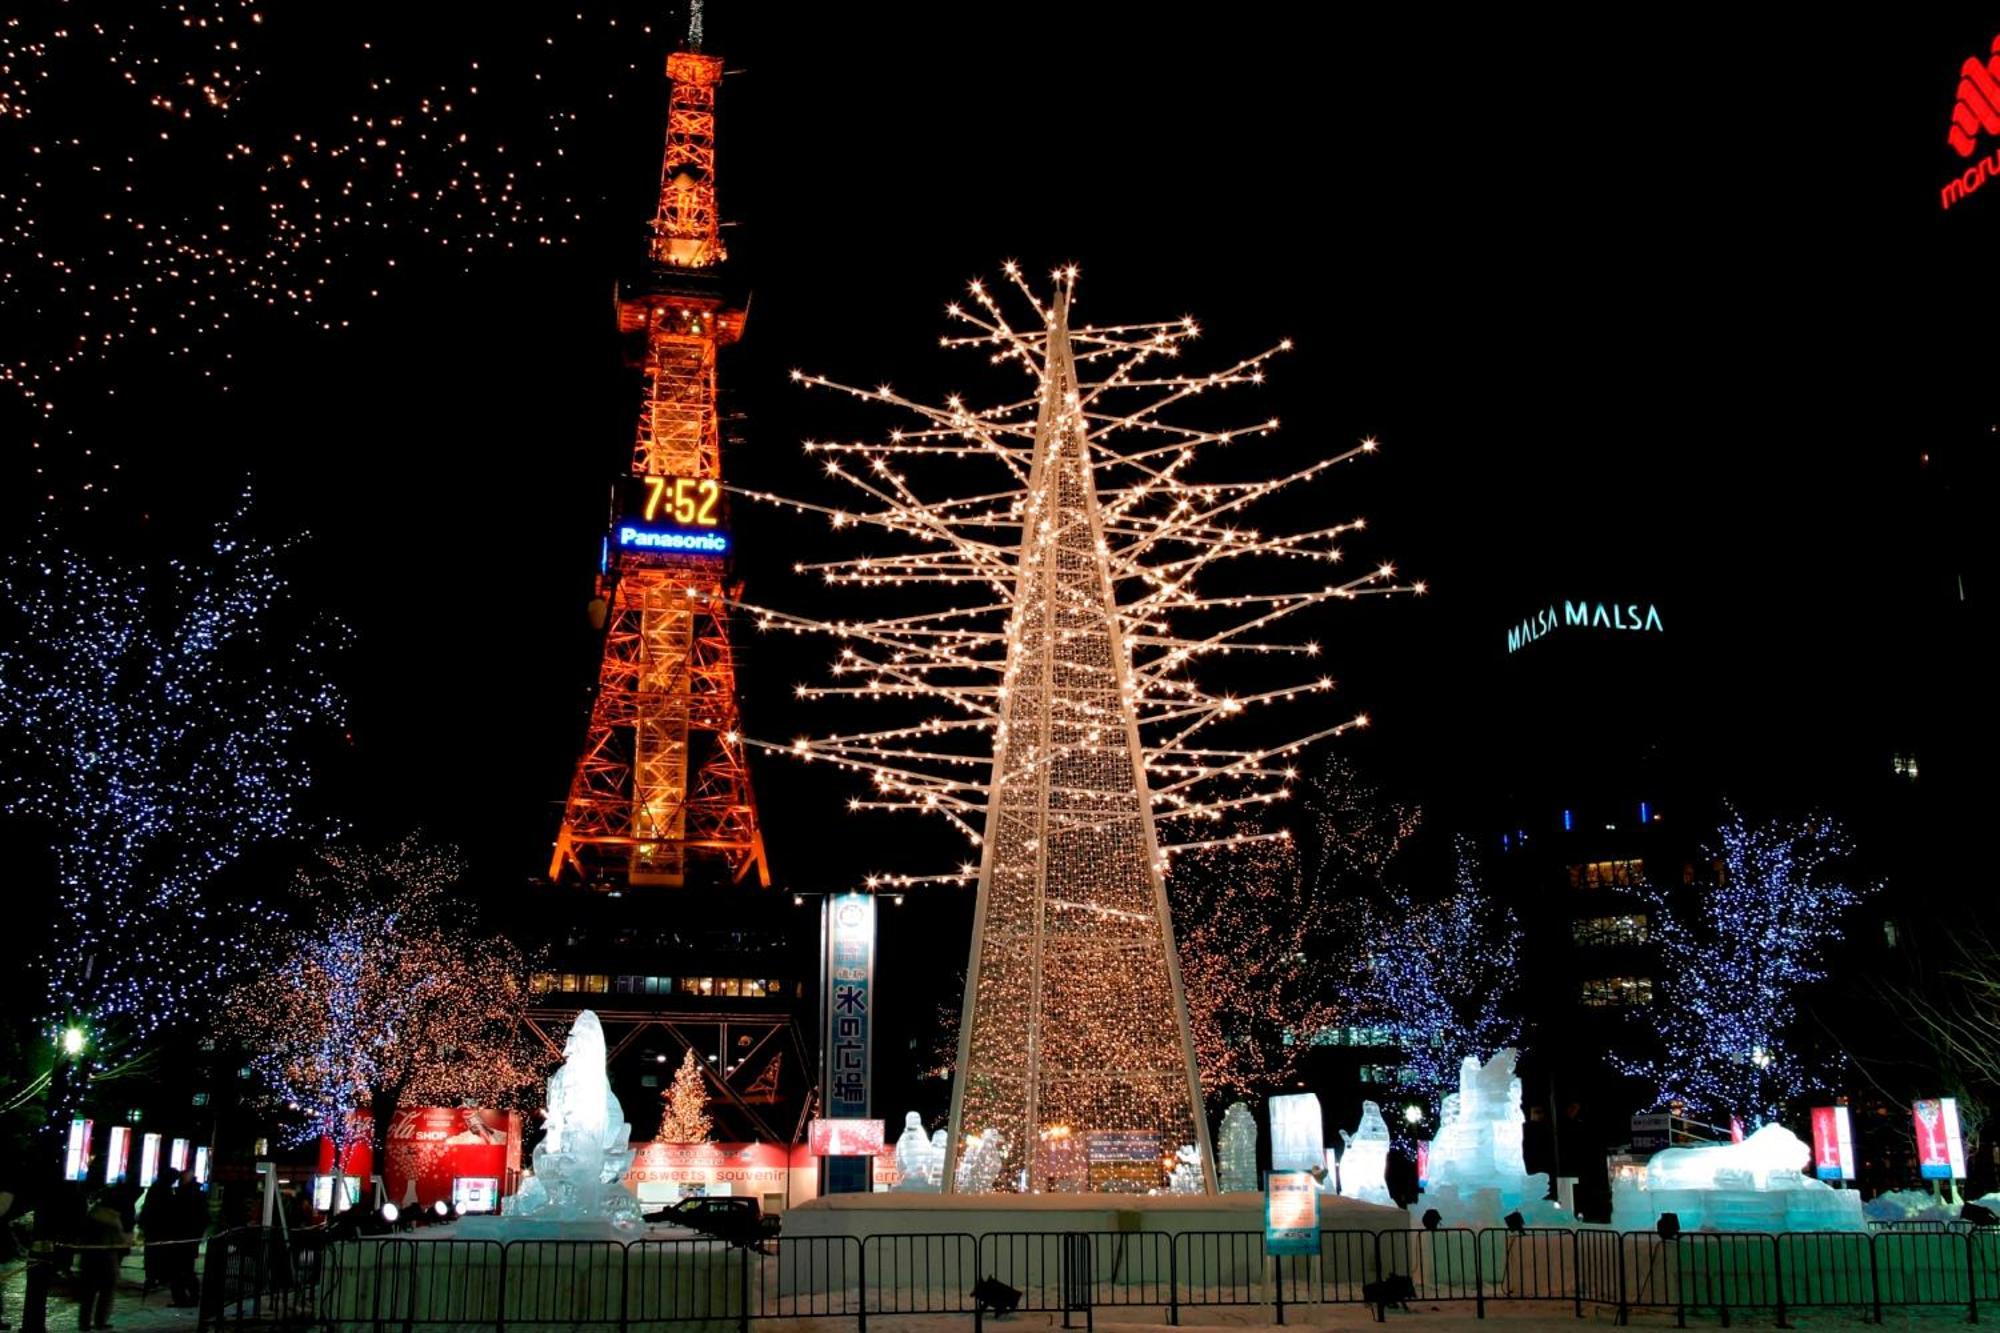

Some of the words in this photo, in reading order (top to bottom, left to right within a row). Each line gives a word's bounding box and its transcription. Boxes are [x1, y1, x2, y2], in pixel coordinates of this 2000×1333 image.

[644, 477, 718, 525] 7:52
[620, 527, 726, 551] Panasonic
[1507, 604, 1558, 653] MALSA
[1565, 600, 1664, 632] MALSA
[834, 985, 866, 1102] 氷の広場
[415, 1131, 448, 1141] SHOP
[650, 1170, 706, 1181] sweets
[716, 1168, 786, 1182] souvenir
